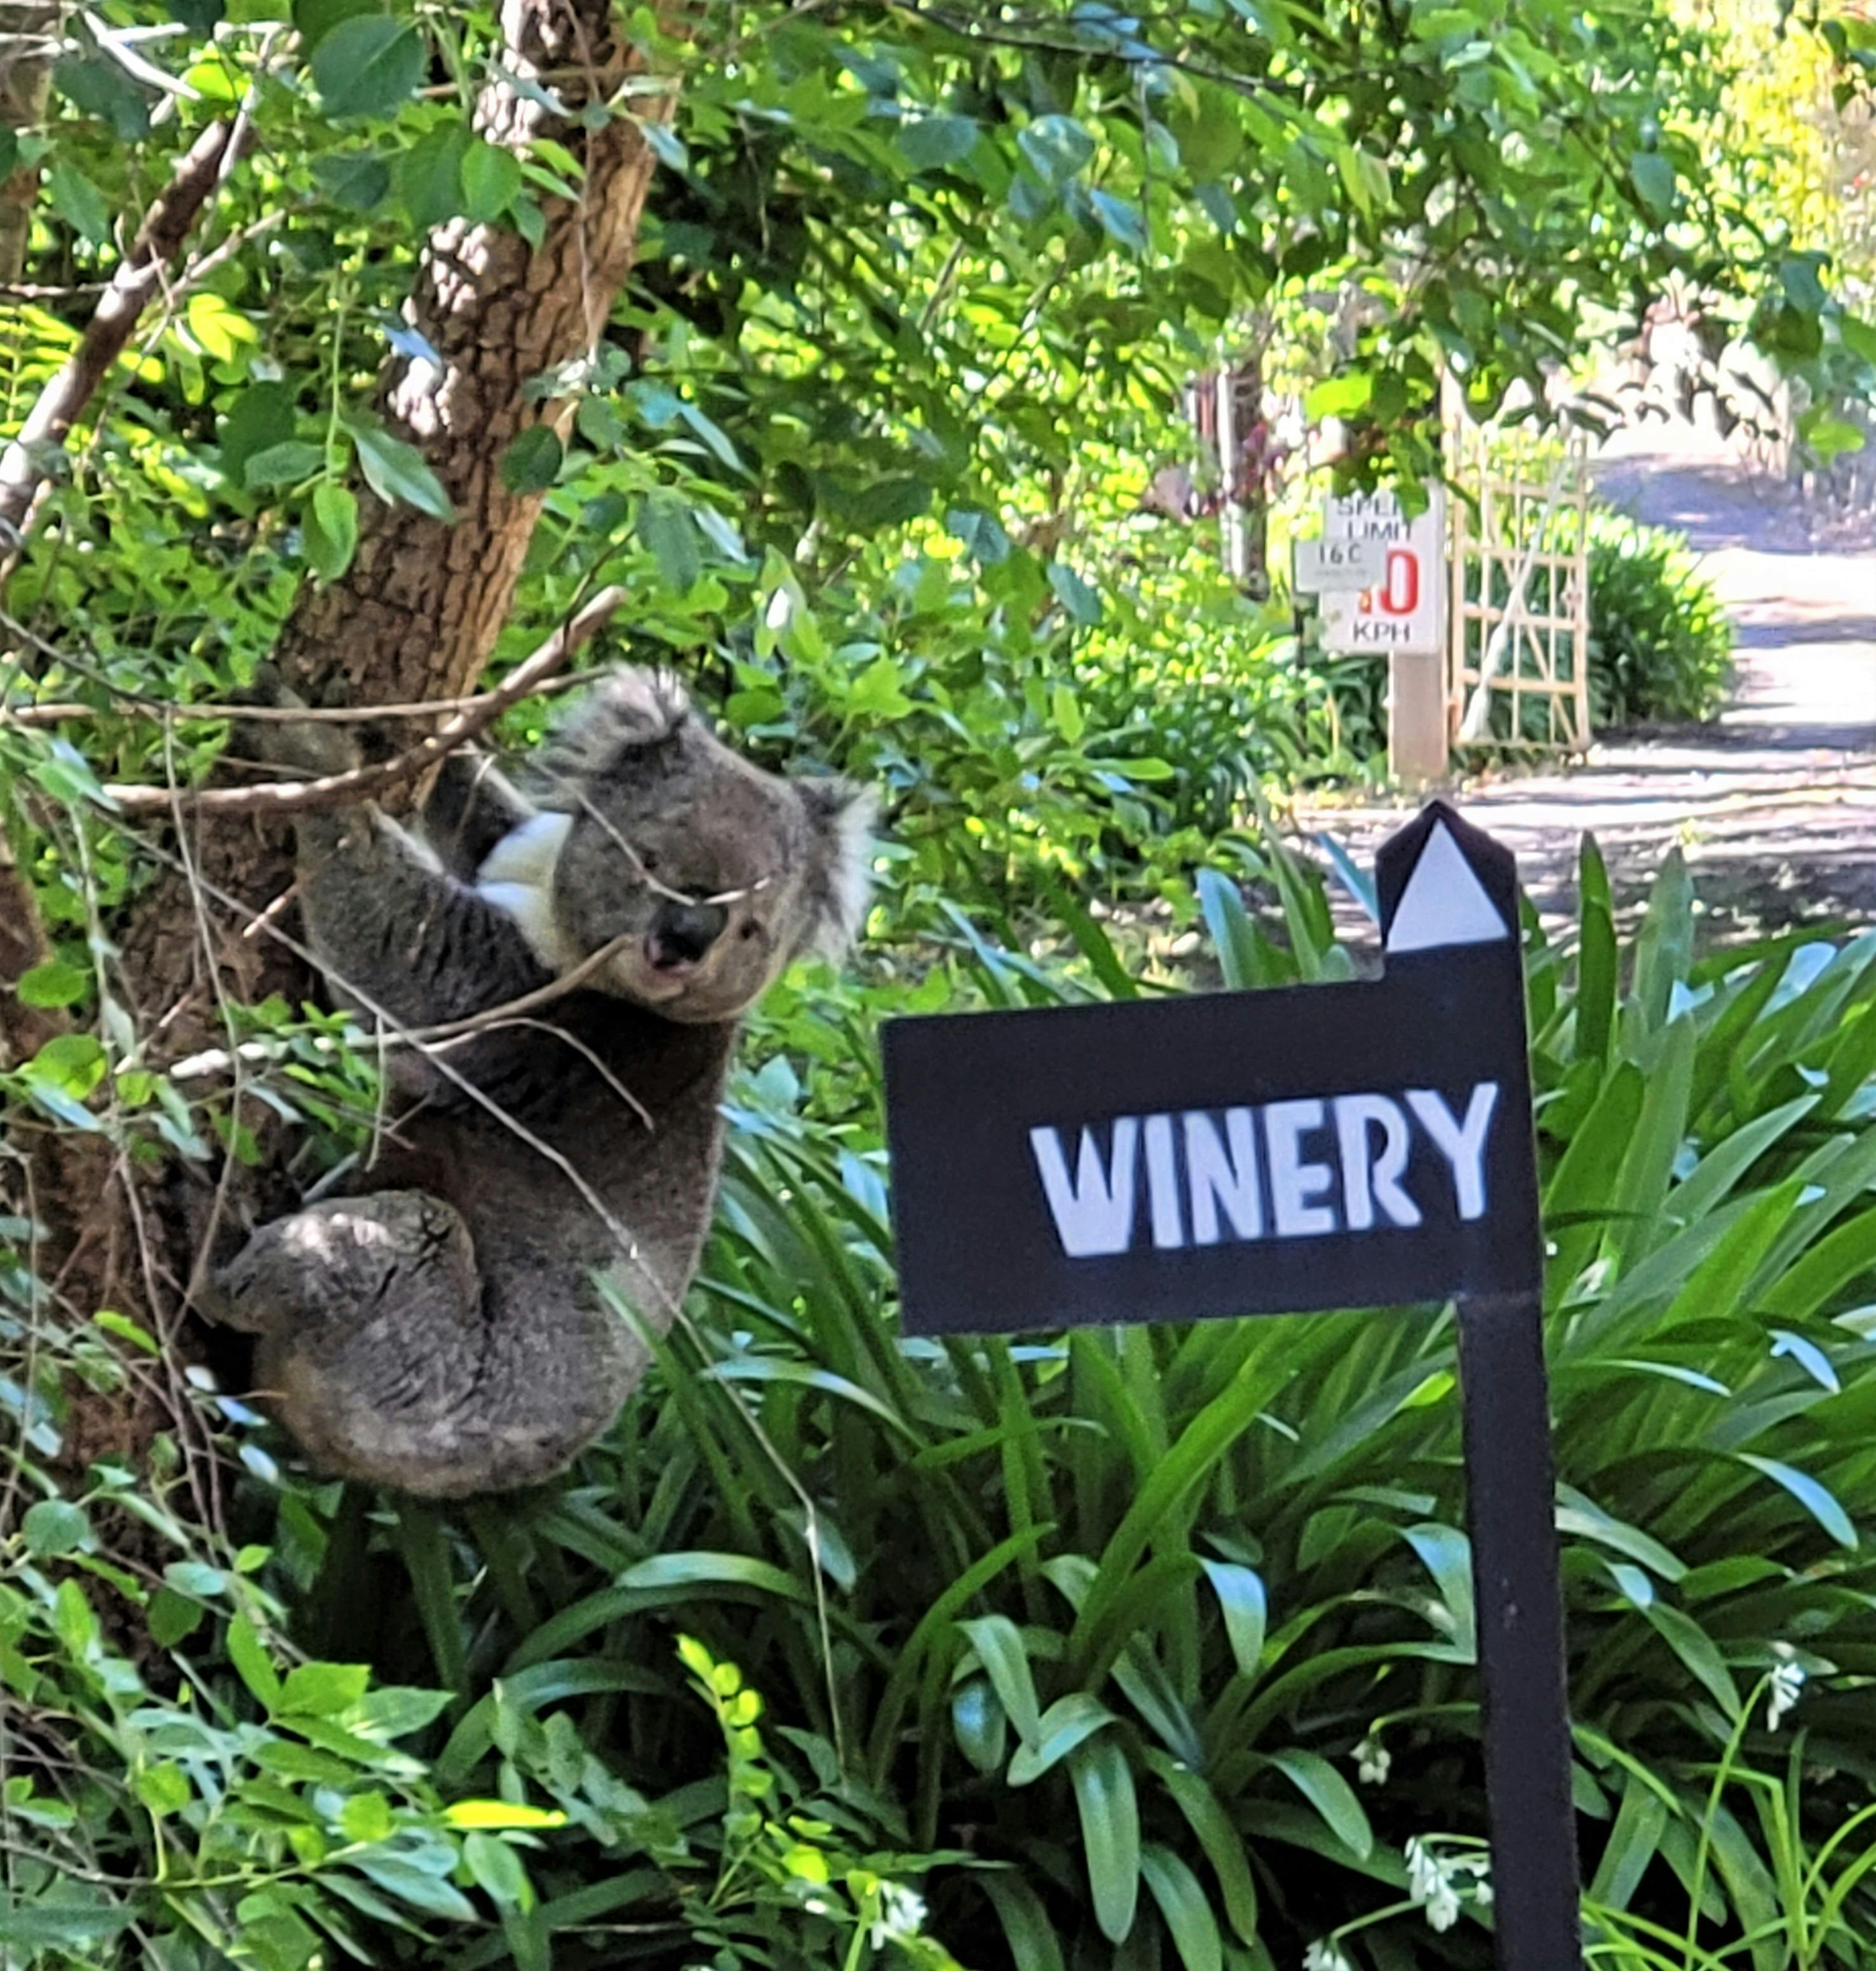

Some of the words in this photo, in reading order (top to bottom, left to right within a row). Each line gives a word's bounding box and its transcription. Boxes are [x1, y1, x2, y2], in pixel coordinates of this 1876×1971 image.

[1347, 522, 1410, 540] LIMIT
[1353, 620, 1410, 642] KPH
[1029, 1081, 1499, 1257] WINERY
